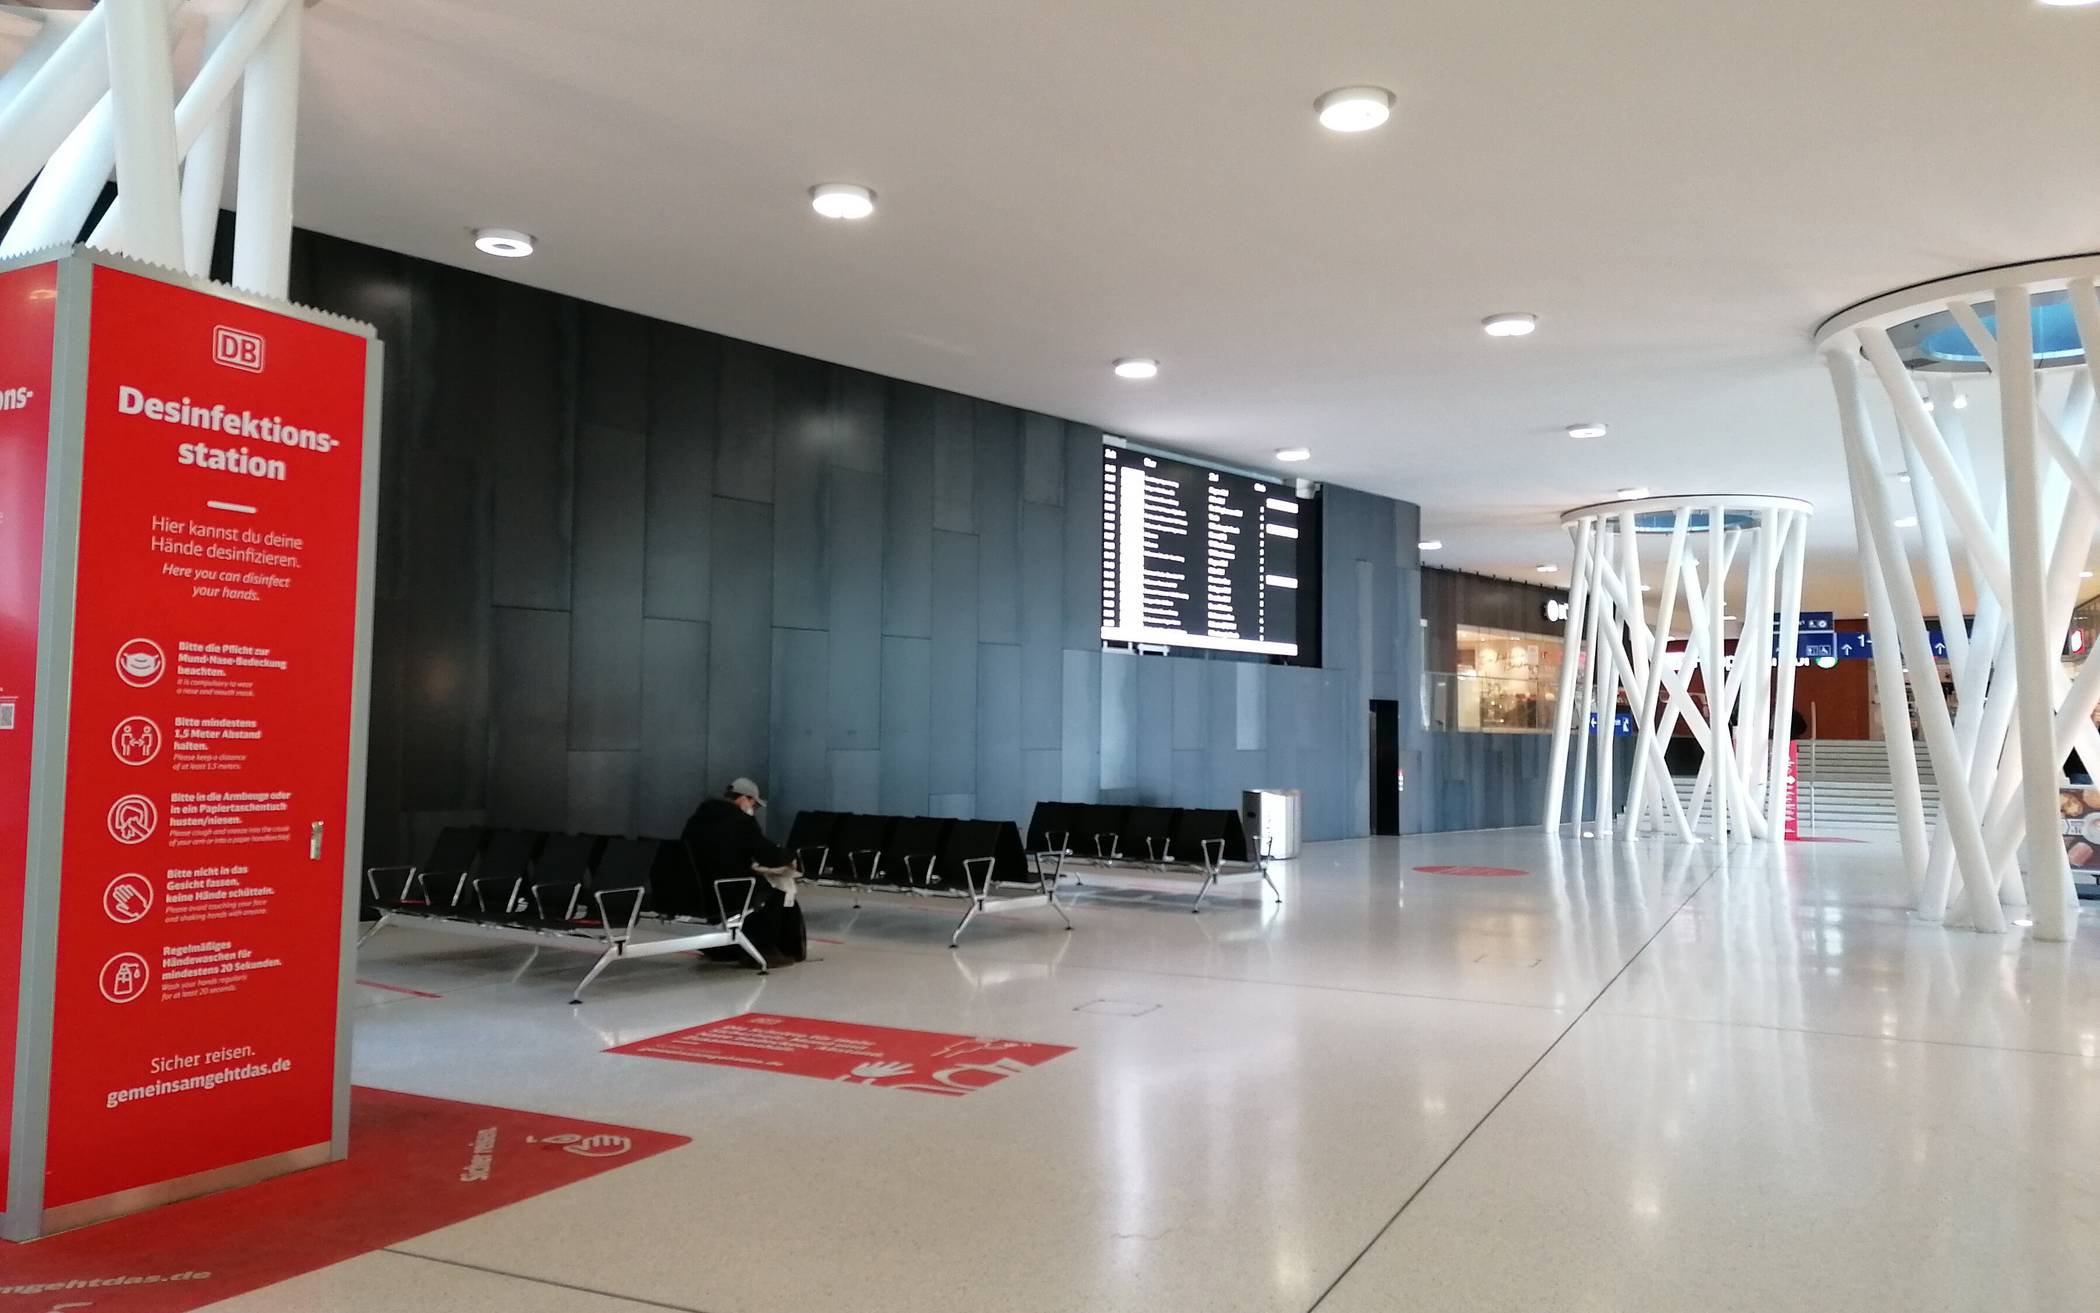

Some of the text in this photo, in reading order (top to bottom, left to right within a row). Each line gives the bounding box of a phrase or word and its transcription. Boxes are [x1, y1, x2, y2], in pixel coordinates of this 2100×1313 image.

[215, 330, 260, 368] DB
[118, 386, 339, 453] Desinfektions-
[178, 441, 286, 481] station
[152, 516, 303, 549] Hier kannst du deine
[151, 537, 301, 568] Hände desinfizieren.
[162, 563, 290, 588] Here you can disinfect
[193, 585, 260, 601] your hands.
[178, 641, 271, 656] Bitte die Pflicht zur
[178, 654, 288, 670] Mund-Nase-Bedeckung
[177, 666, 227, 676] beachten.
[175, 716, 257, 728] Bitte mindestens
[175, 729, 262, 740] 1,5 Meter Abstand
[173, 741, 208, 751] halten.
[171, 791, 291, 802] Bitte in die Armbeuge oder
[170, 803, 287, 814] in ein Papiertaschentuch
[169, 816, 242, 827] husten/niesen.
[167, 865, 249, 879] Bitte nicht in das
[166, 880, 204, 891] Gesicht
[166, 887, 275, 903] keine Hände schütteln.
[163, 941, 232, 956] Regelmäßiges
[162, 950, 252, 968] Händewaschen für
[162, 958, 282, 981] mindestens 20 Sekunden.
[150, 1044, 256, 1075] Sicher reisen.
[106, 1055, 292, 1109] gemeinsamgehtdas.de
